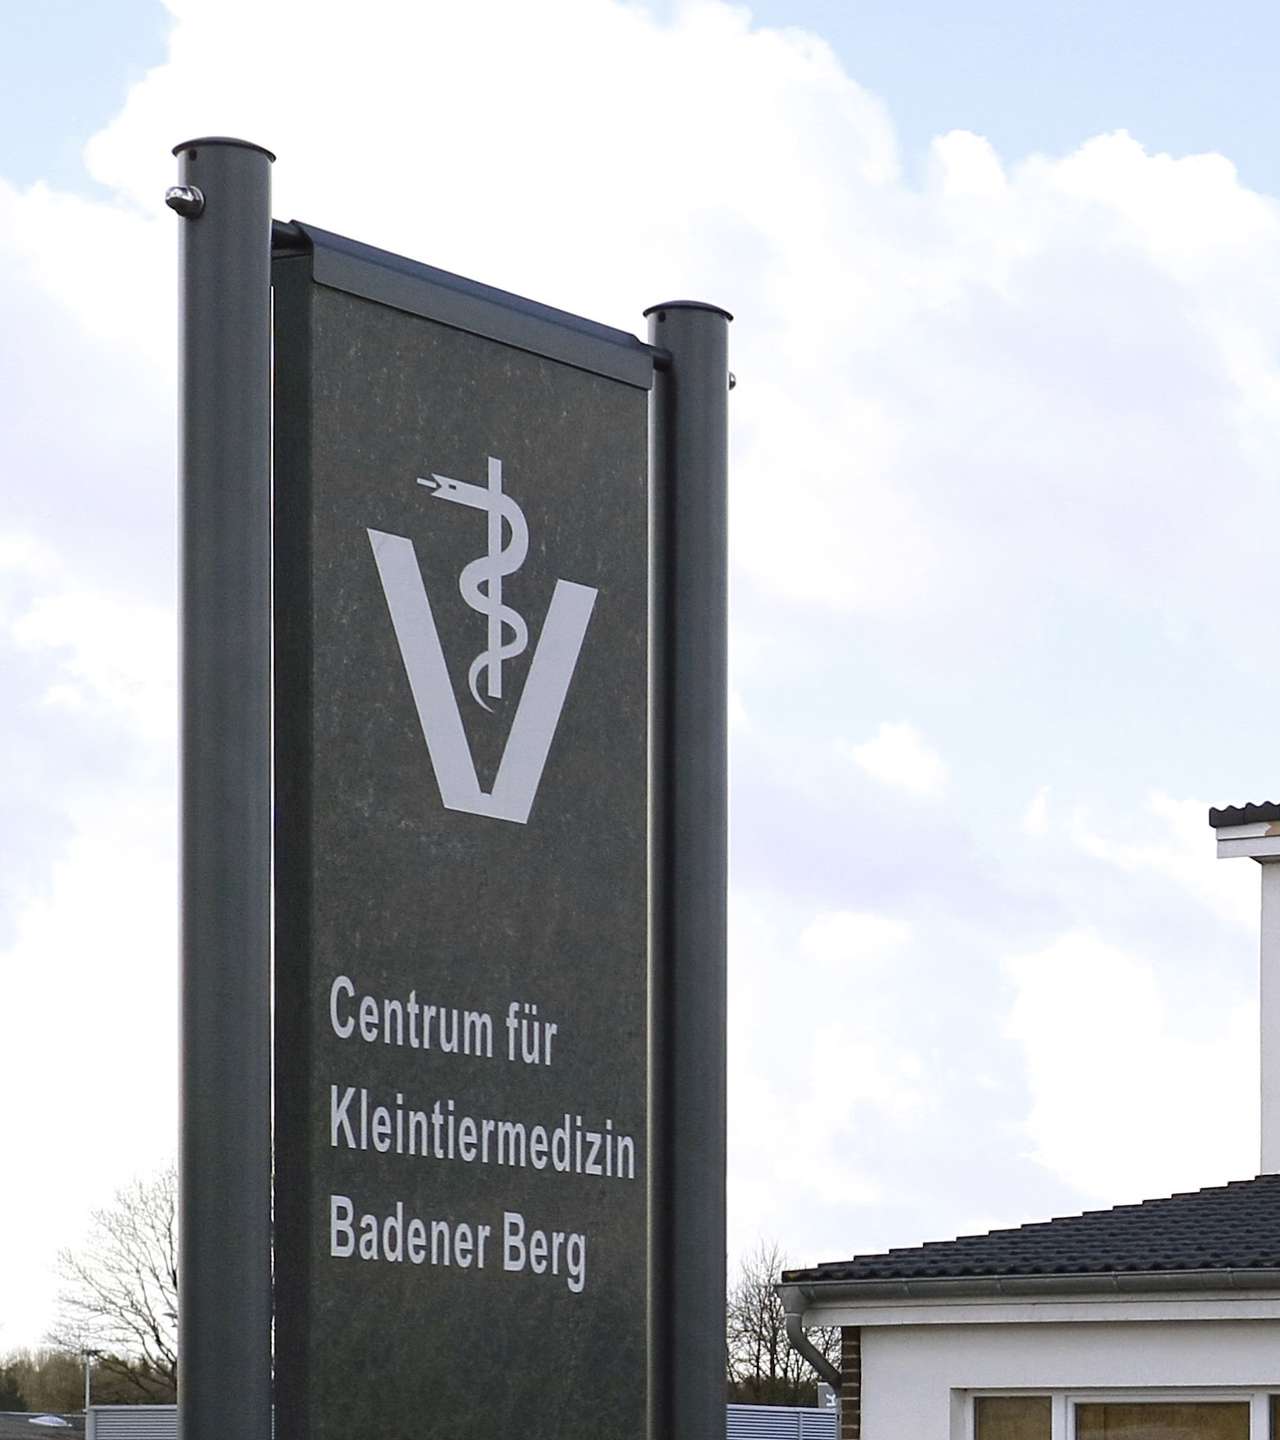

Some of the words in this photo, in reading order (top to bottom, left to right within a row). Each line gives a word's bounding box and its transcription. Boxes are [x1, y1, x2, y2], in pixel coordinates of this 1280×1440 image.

[329, 975, 493, 1058] Centrum
[505, 1001, 558, 1066] für
[330, 1084, 635, 1179] Kleintiermedizin
[330, 1194, 490, 1270] Badener
[503, 1211, 587, 1293] Berg
